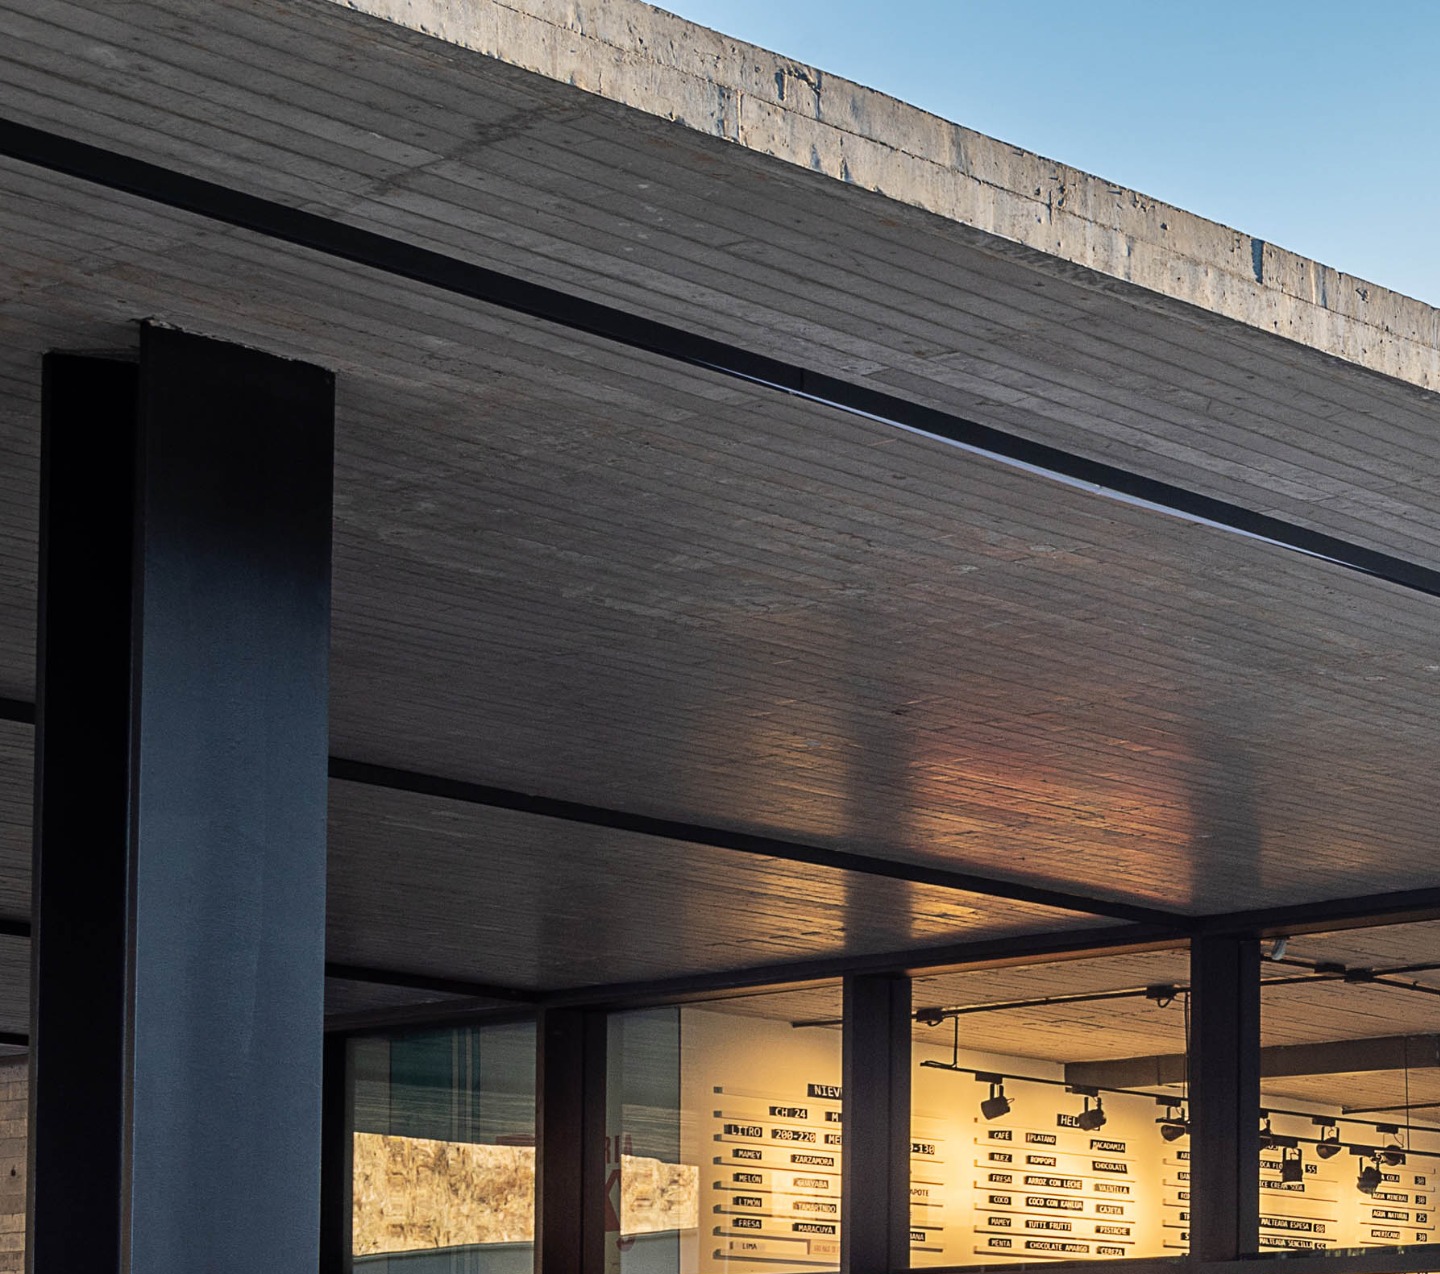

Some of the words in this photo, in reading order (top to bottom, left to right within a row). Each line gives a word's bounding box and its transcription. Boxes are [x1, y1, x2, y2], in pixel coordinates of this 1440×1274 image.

[814, 1085, 842, 1098] NIEV
[775, 1108, 788, 1117] CH
[794, 1109, 806, 1119] 24
[731, 1125, 761, 1137] LITRO
[738, 1150, 761, 1159] MAMEY
[795, 1155, 833, 1166] ZARZAMORA
[1030, 1156, 1055, 1166] ROMPOPE
[1095, 1162, 1126, 1172] CHOCOLATE
[992, 1175, 1011, 1183] FRESA
[1028, 1177, 1047, 1186] ARROZ
[1049, 1179, 1061, 1187] CON
[1063, 1180, 1082, 1189] LECHE
[798, 1203, 836, 1213] TAMARINDO
[994, 1196, 1009, 1204] COCO
[1028, 1197, 1044, 1206] COCO
[1046, 1199, 1058, 1207] CON
[1100, 1206, 1122, 1215] CAJETA
[1387, 1212, 1408, 1220] NATURAL
[1417, 1213, 1426, 1222] 25
[738, 1219, 760, 1228] FRESA
[991, 1218, 1010, 1226] MAMEY
[1028, 1221, 1046, 1229] TUTTI
[1049, 1222, 1071, 1230] FRUTTI
[1290, 1222, 1309, 1230] ESPESA
[991, 1239, 1010, 1247] MENTA
[1030, 1242, 1062, 1251] CHOCOLATE
[1101, 1247, 1123, 1256] CEREZA
